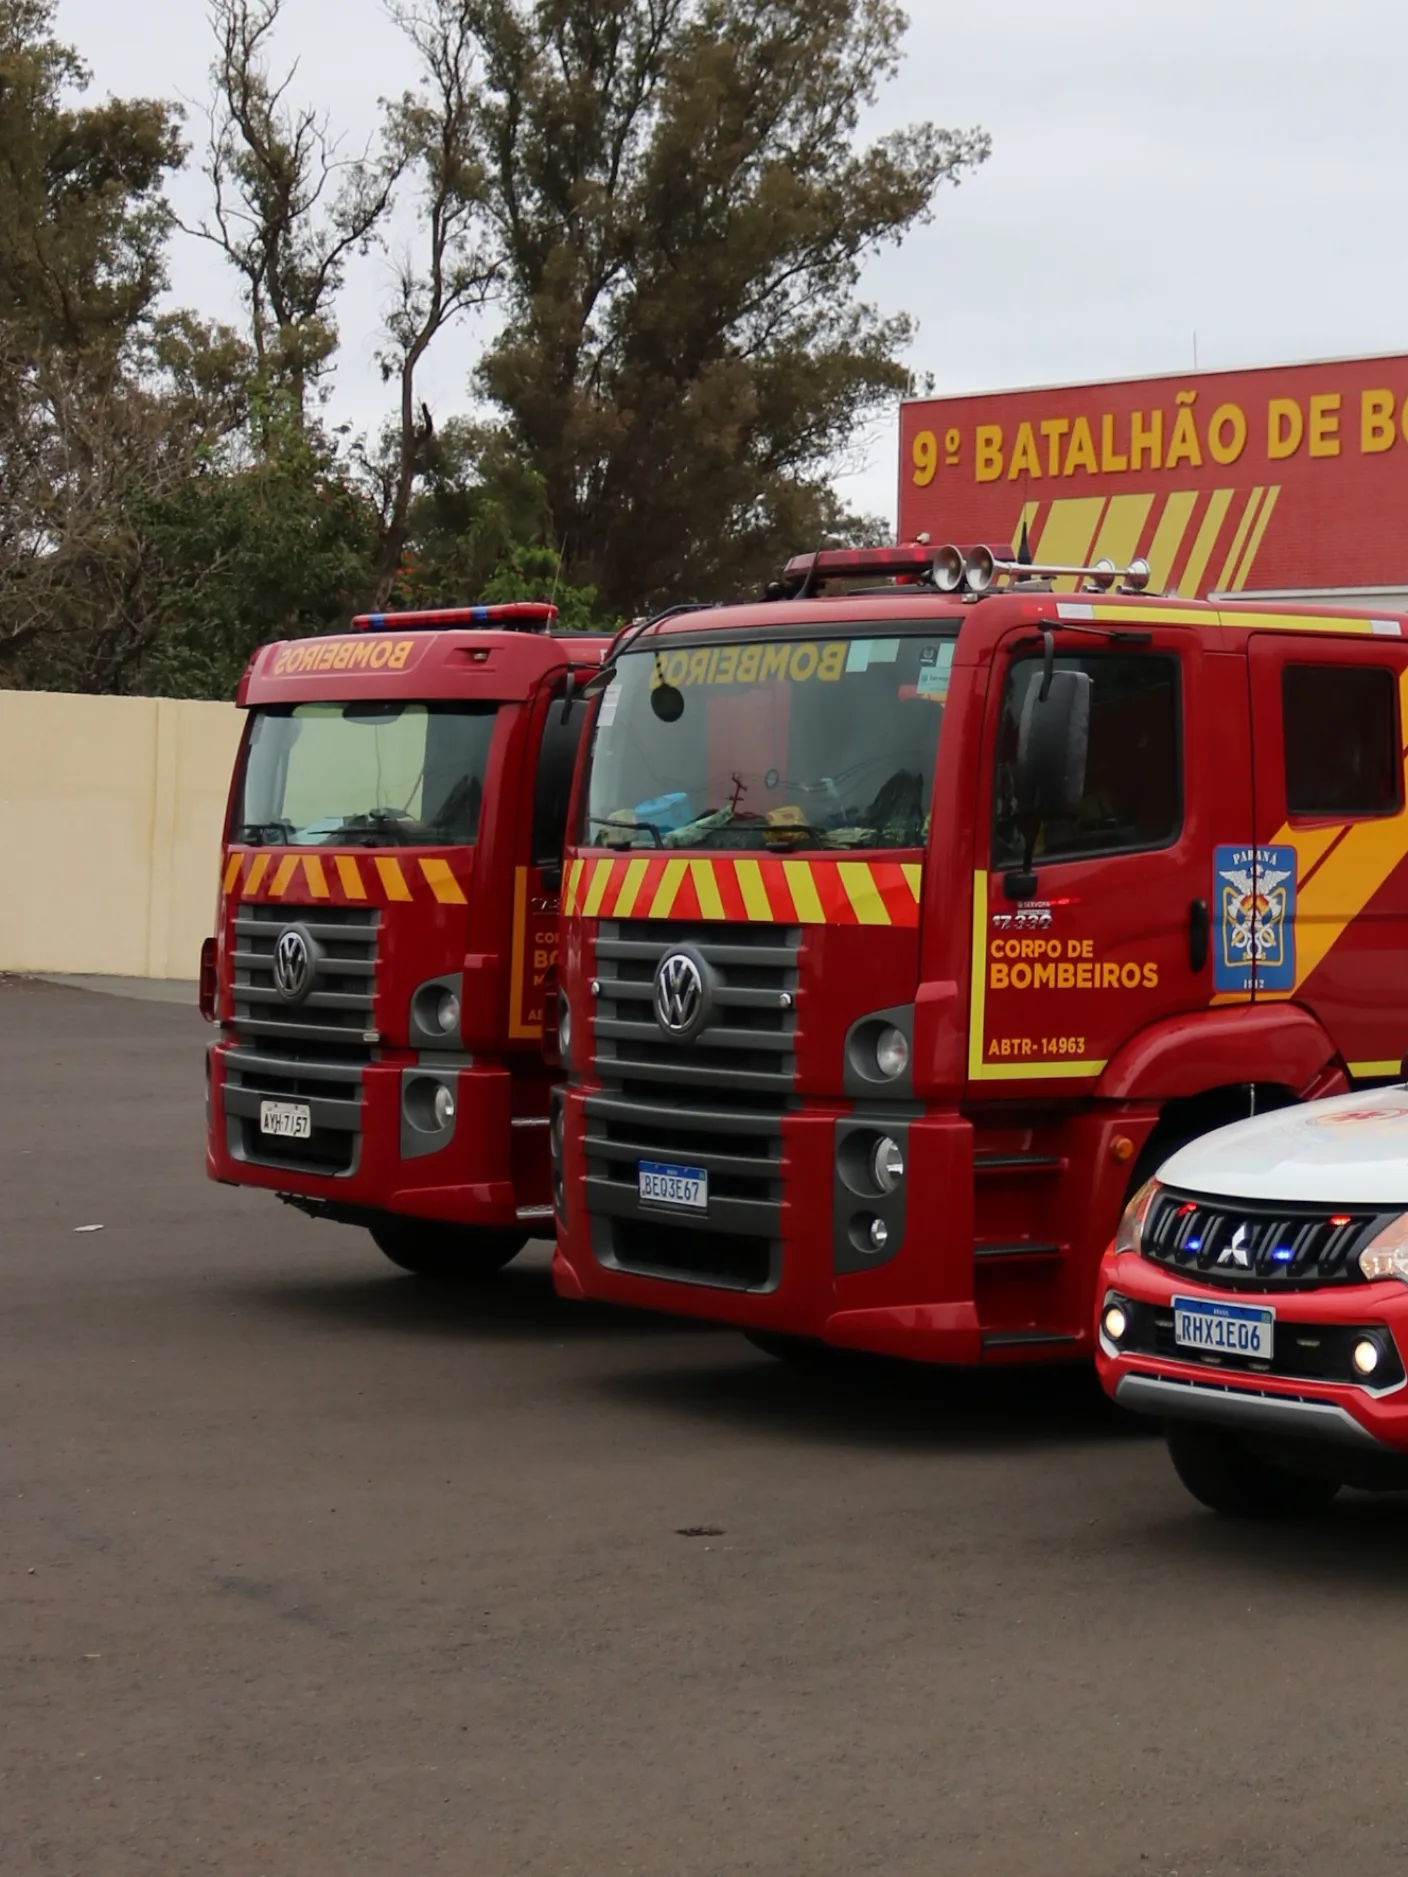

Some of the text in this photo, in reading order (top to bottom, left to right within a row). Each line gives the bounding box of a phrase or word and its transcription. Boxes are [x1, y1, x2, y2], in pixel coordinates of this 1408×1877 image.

[975, 390, 1248, 482] BATALHÃO
[1267, 393, 1341, 460] DE
[991, 939, 1094, 959] CORPO DE
[990, 962, 1158, 989] BOMBEIROS
[1182, 1314, 1261, 1351] RHX1E06
